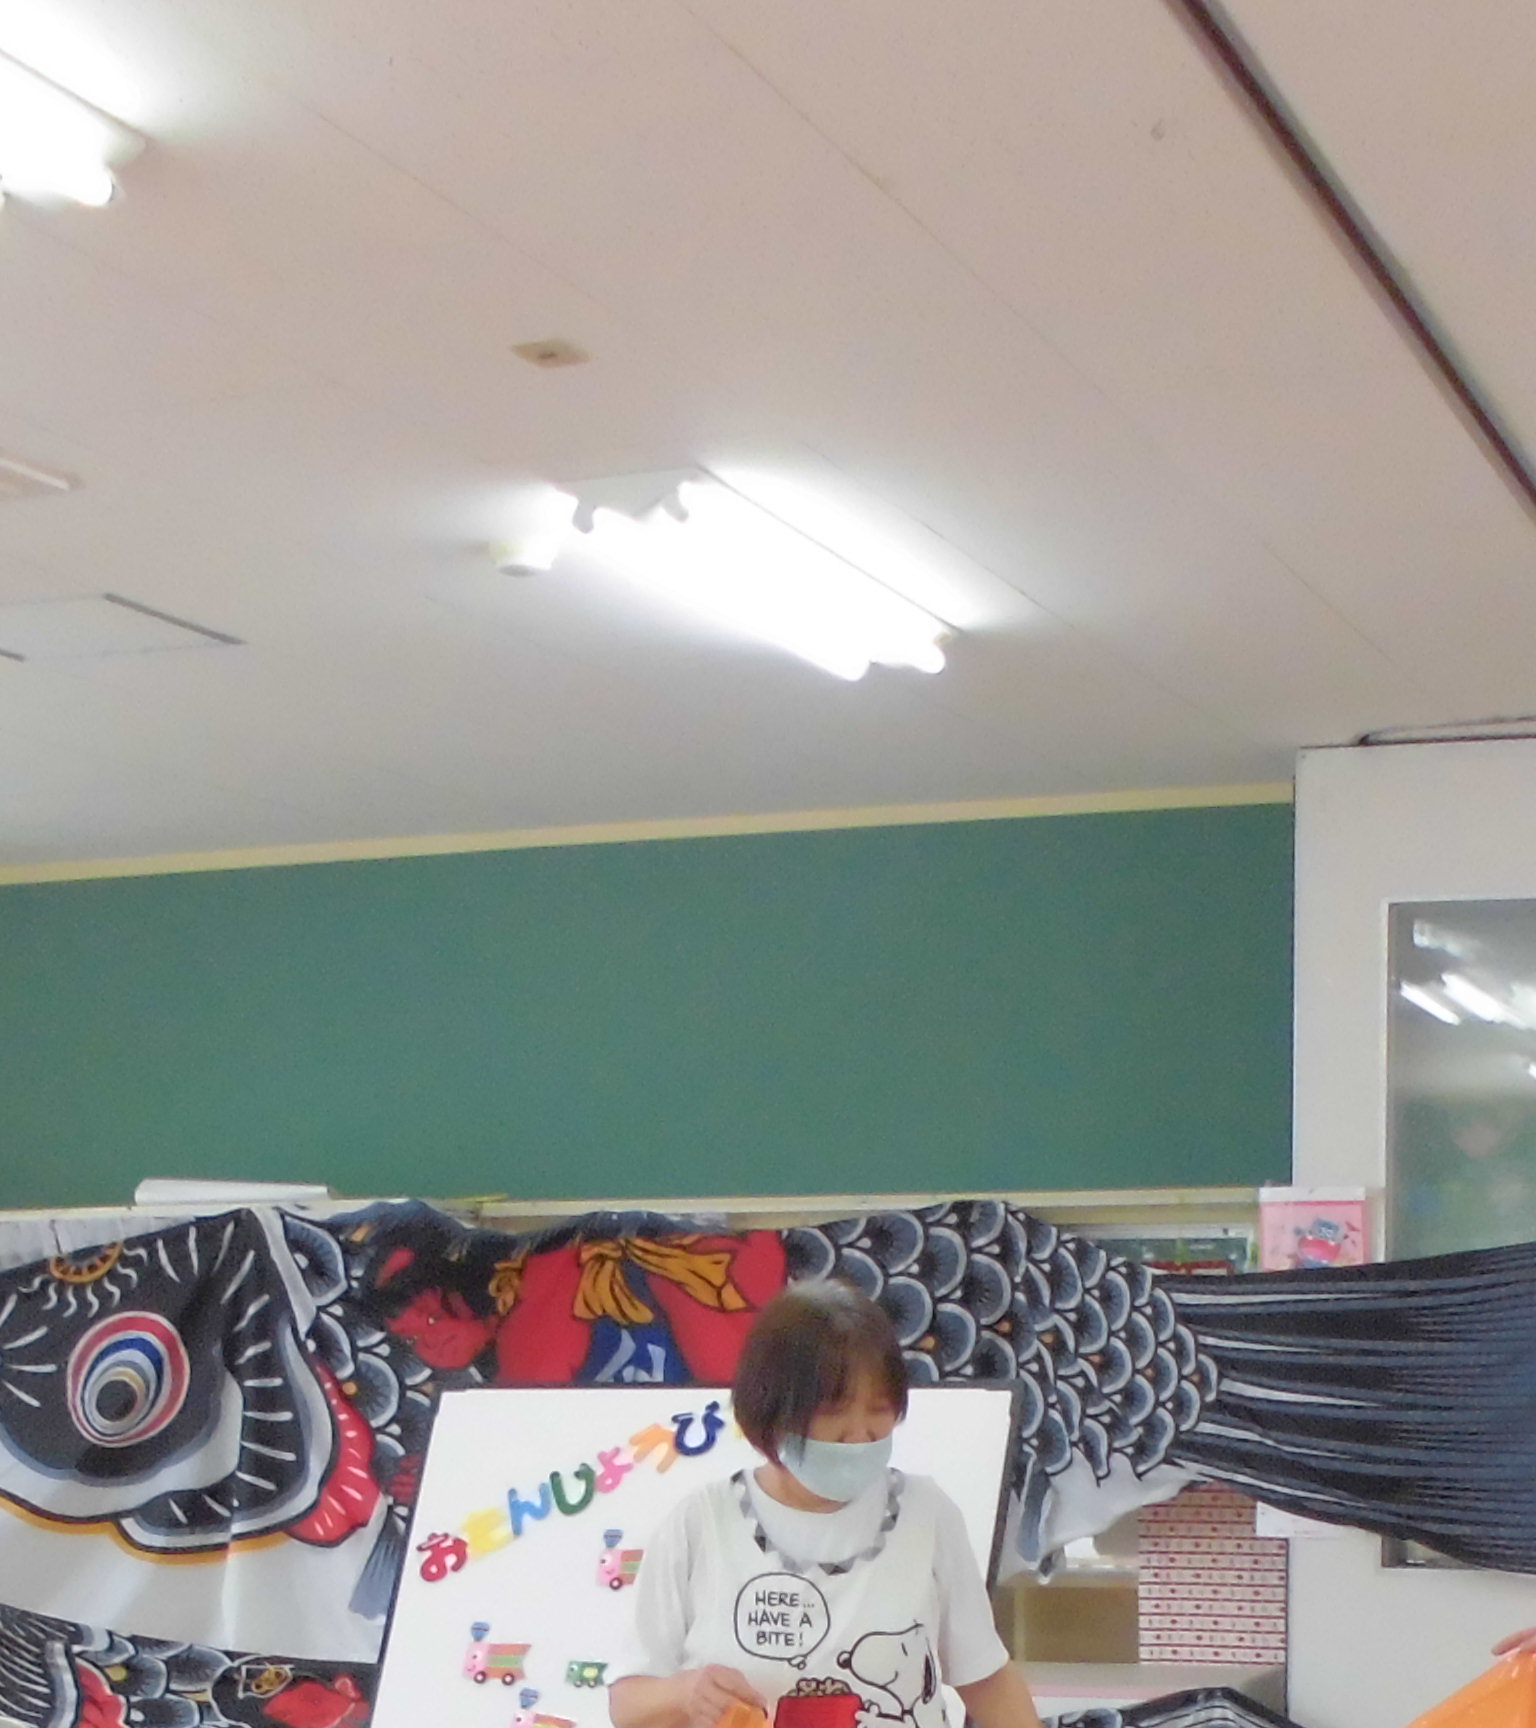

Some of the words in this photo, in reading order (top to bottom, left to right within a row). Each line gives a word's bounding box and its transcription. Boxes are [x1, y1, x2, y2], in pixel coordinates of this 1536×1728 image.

[748, 1609, 790, 1628] HAVE
[799, 1611, 813, 1628] A
[756, 1630, 804, 1648] BITE!
